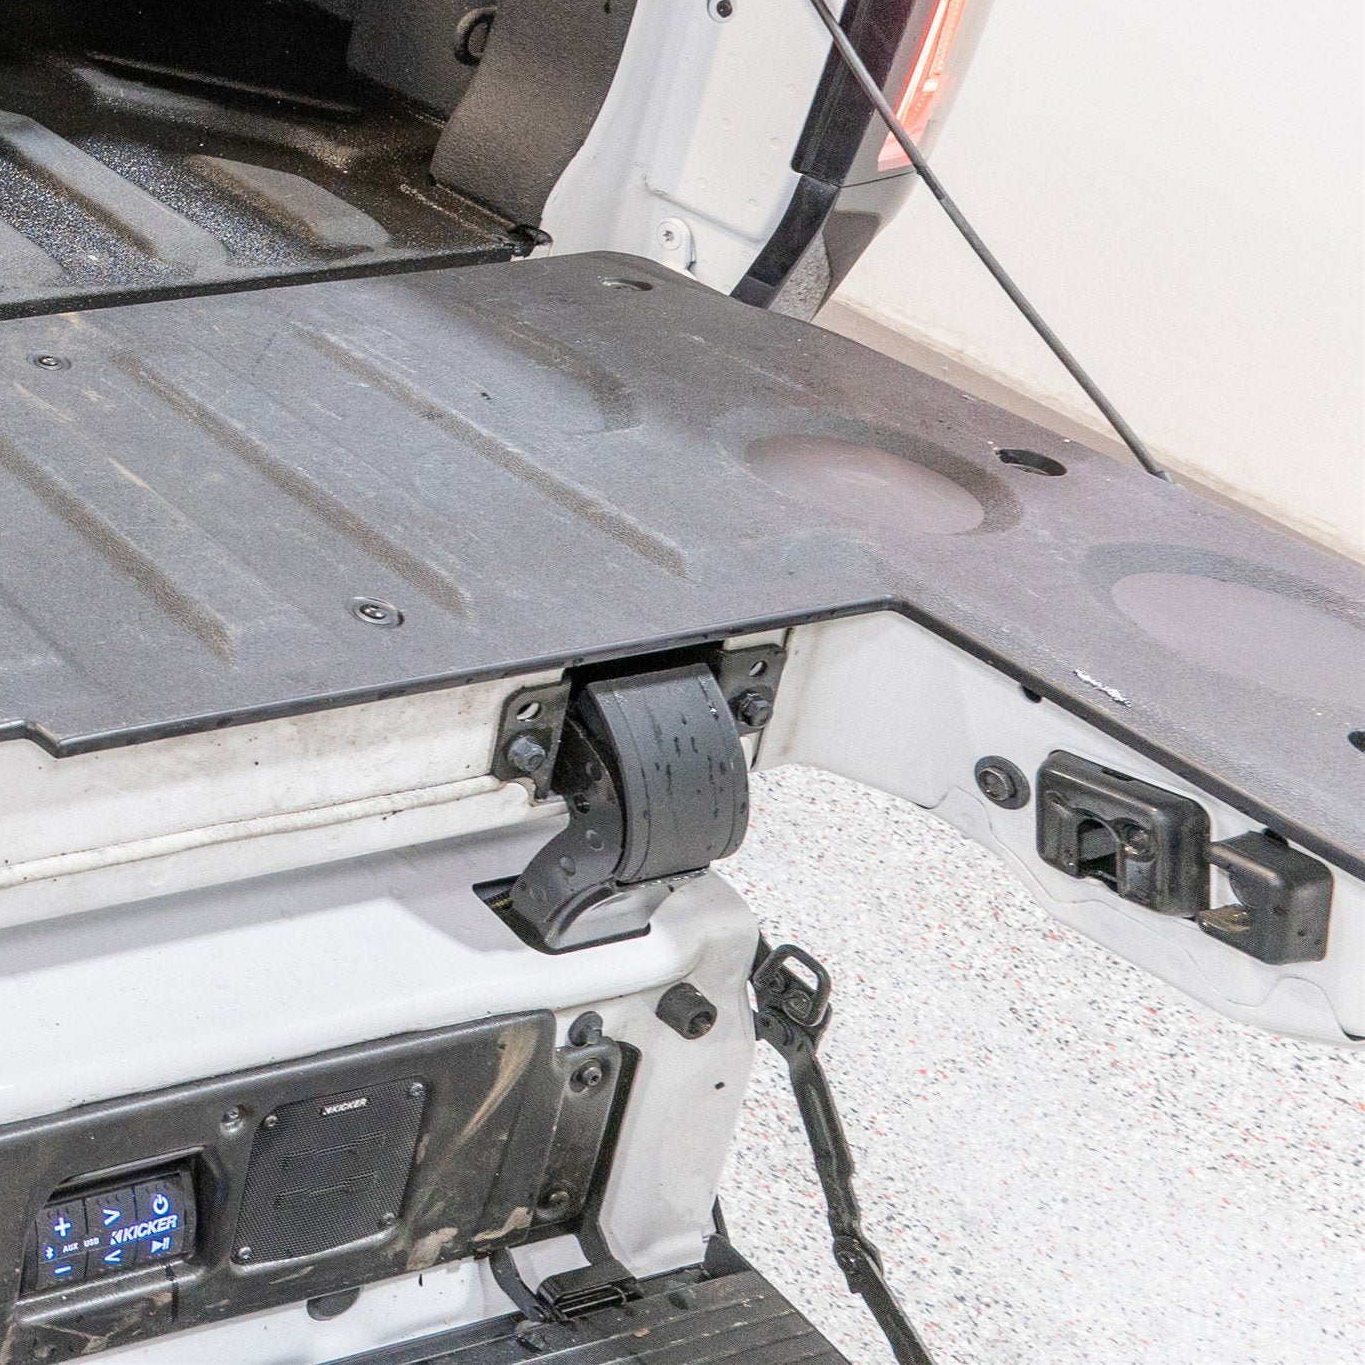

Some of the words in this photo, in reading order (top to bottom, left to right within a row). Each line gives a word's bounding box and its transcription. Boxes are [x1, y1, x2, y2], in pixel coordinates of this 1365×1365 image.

[331, 1098, 368, 1114] KICKER
[122, 1214, 178, 1243] KICKER
[62, 1241, 79, 1254] AUX
[83, 1237, 100, 1248] USB
